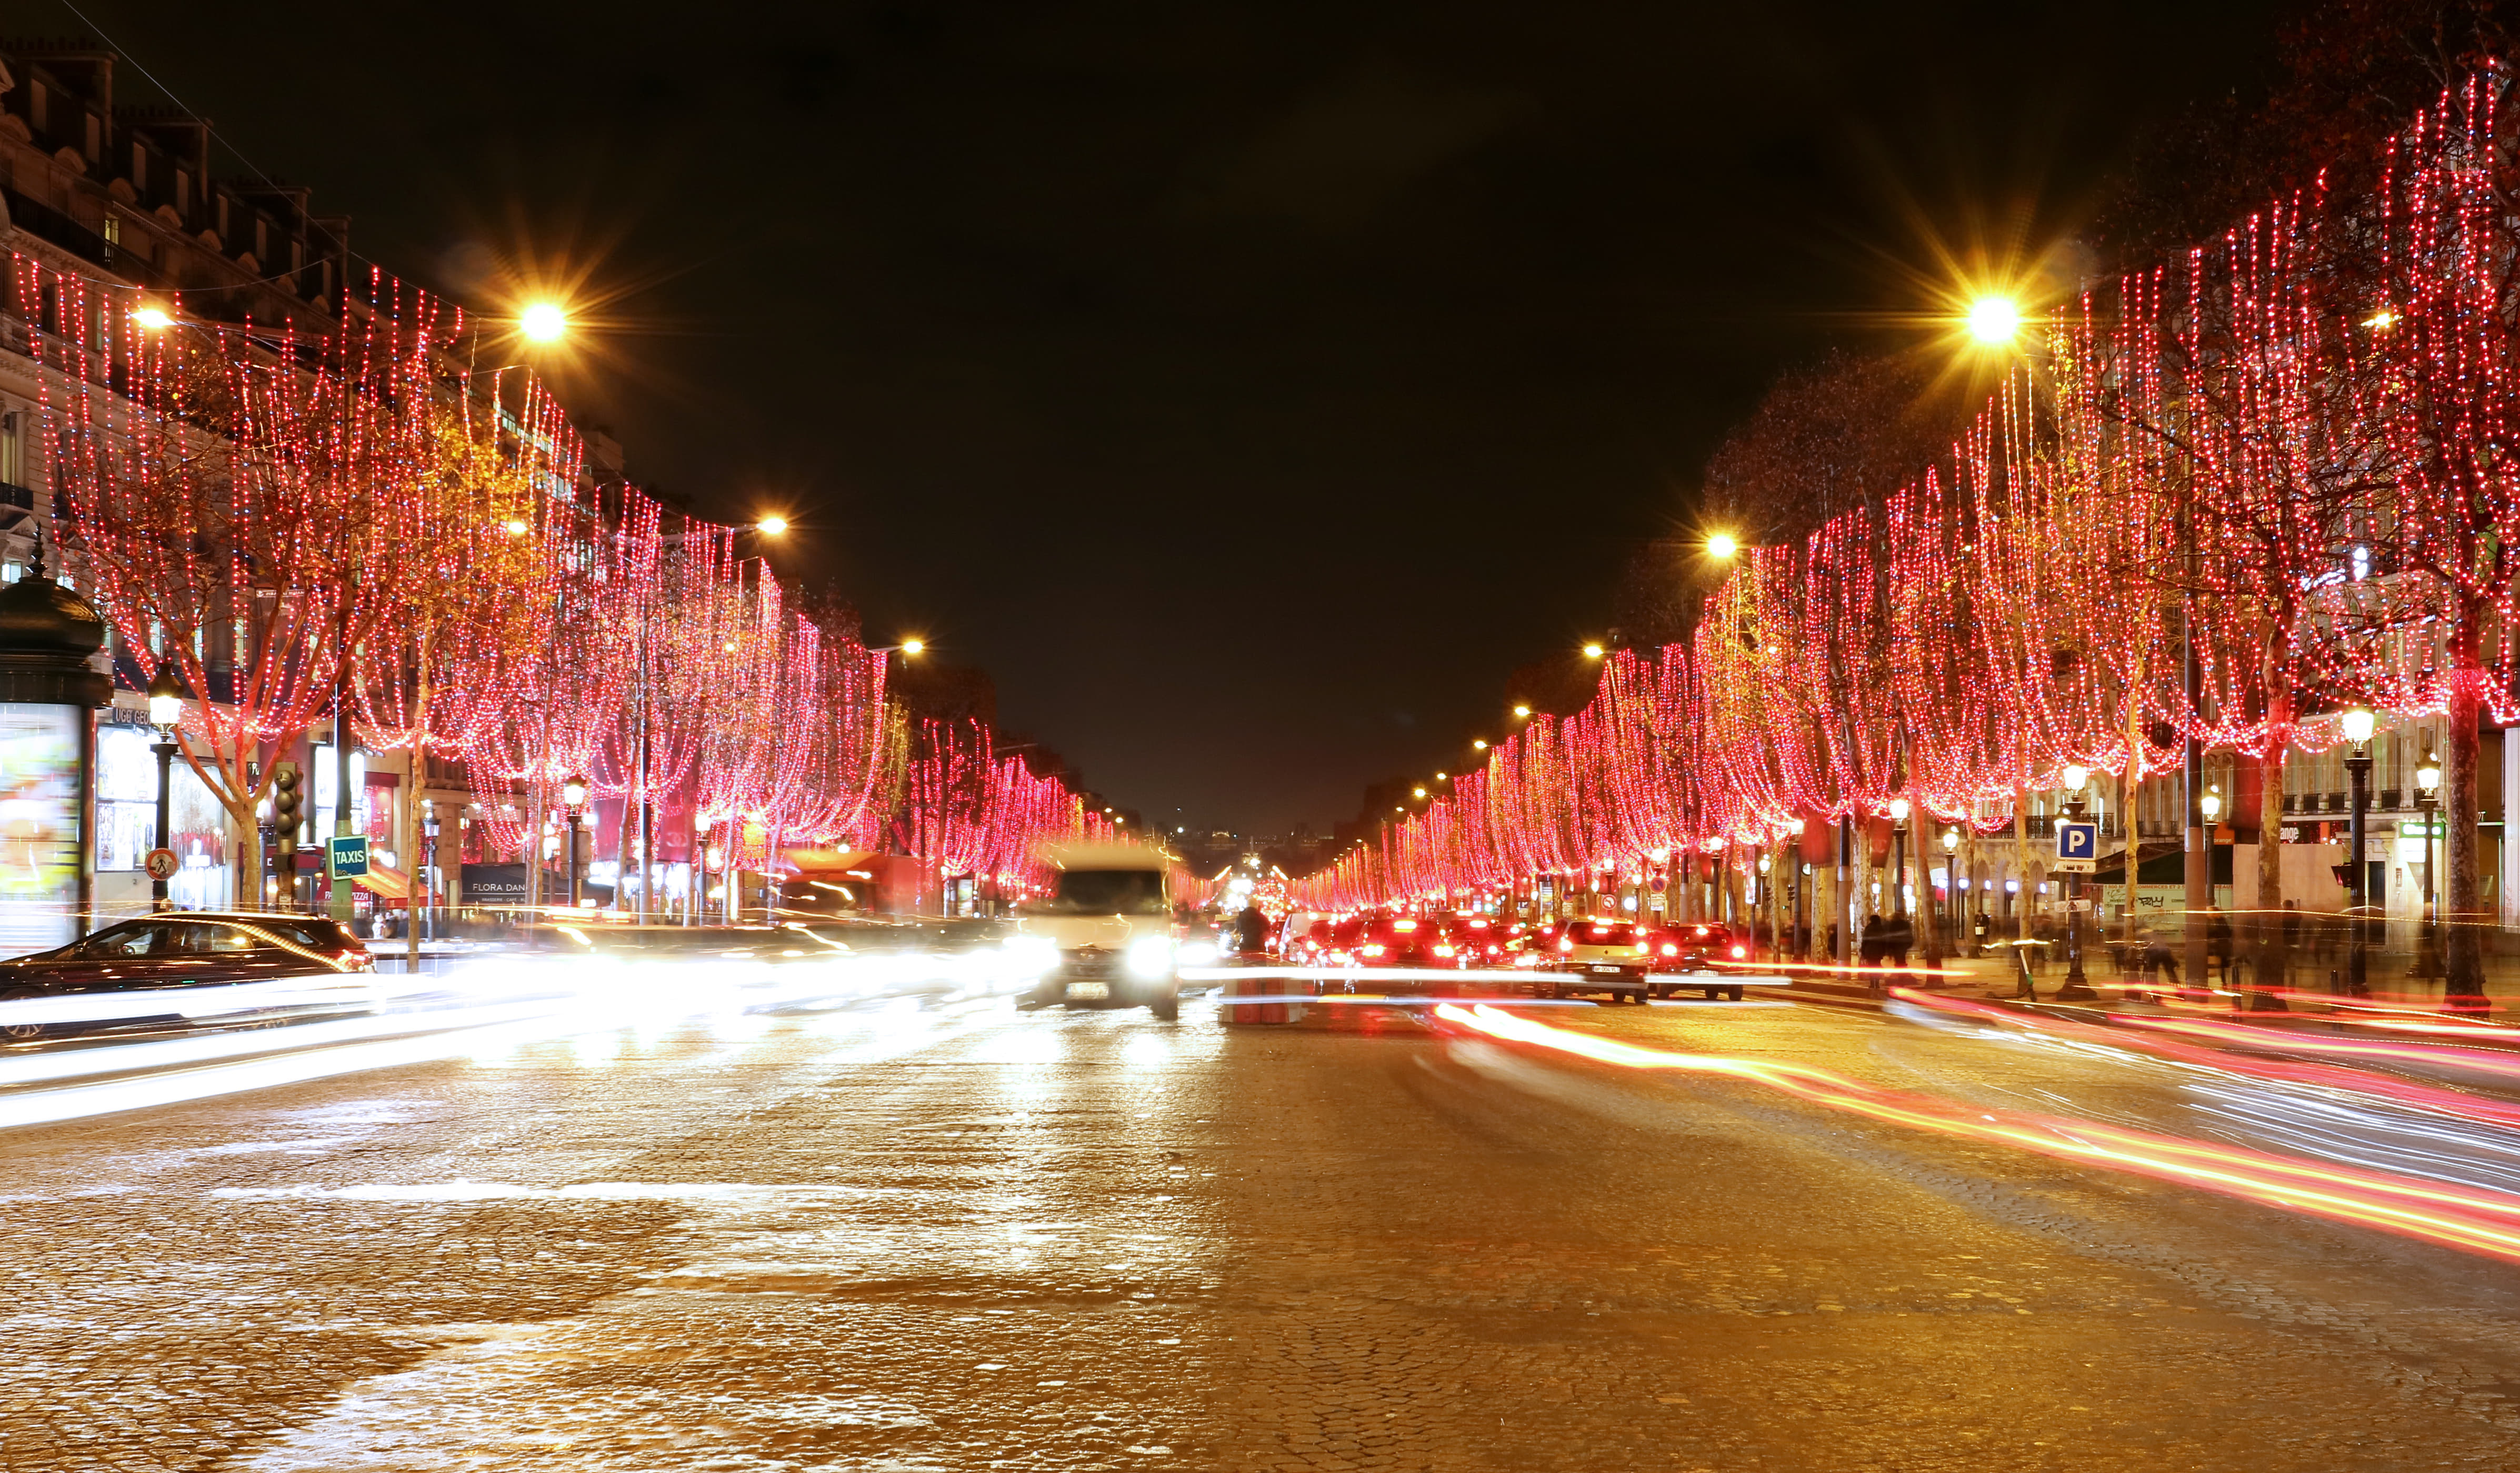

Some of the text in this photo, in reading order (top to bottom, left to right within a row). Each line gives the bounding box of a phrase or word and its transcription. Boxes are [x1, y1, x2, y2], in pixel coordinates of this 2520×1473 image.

[135, 710, 150, 725] GEO
[2069, 830, 2085, 852] P
[2280, 827, 2299, 843] ange
[335, 850, 364, 864] TAXIS
